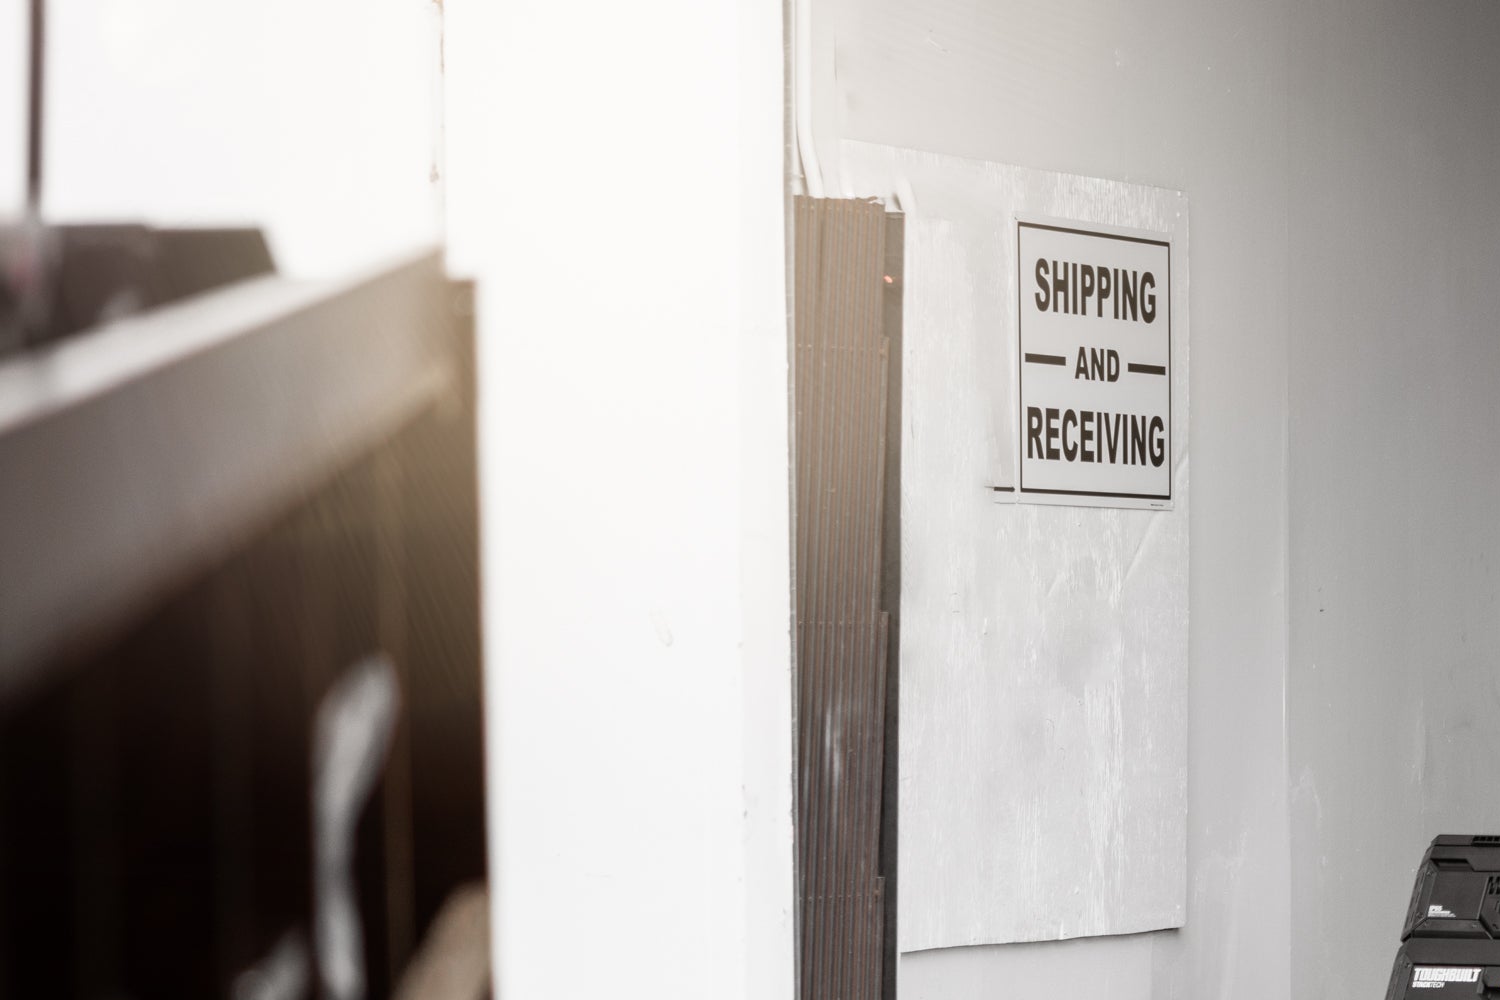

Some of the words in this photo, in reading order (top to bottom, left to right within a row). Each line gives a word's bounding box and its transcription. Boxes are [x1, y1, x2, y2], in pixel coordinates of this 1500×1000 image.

[1035, 258, 1156, 323] SHIPPING
[1075, 346, 1120, 382] AND
[1027, 406, 1165, 467] RECEIVING
[1414, 968, 1481, 982] TOUGHBUILT
